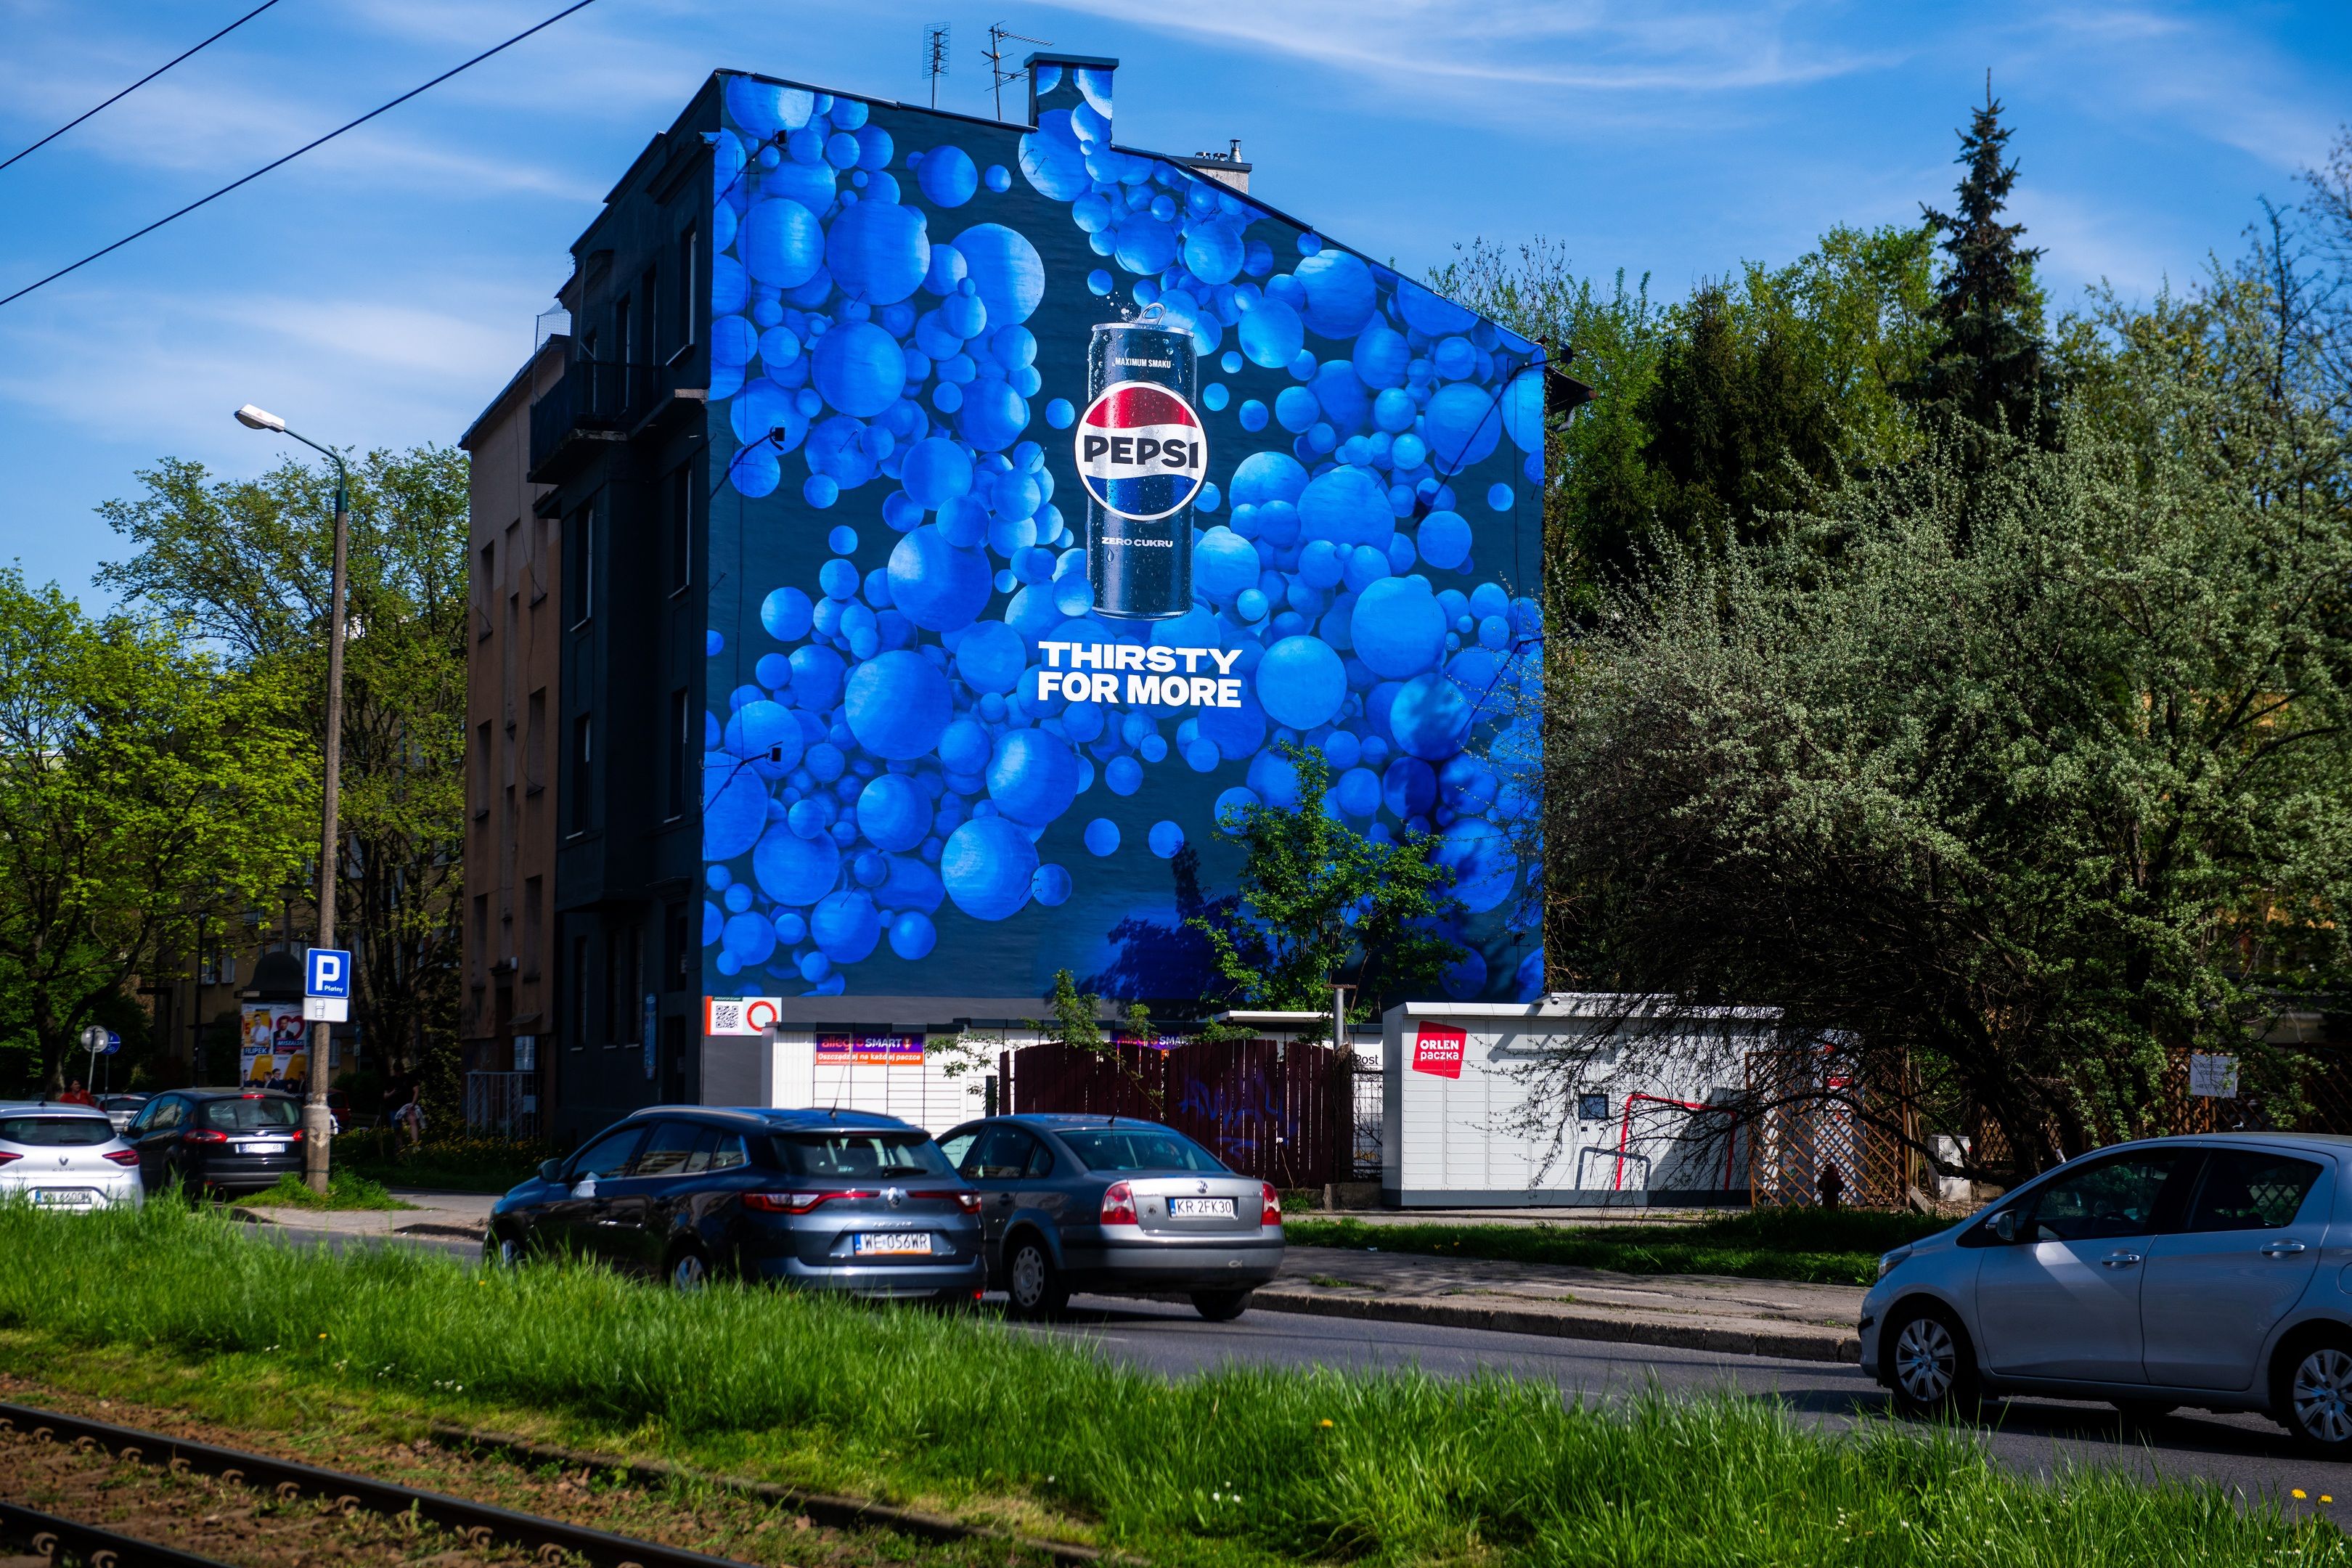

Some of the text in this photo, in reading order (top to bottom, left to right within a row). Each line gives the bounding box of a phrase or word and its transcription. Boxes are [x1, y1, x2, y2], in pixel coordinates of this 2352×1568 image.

[1115, 357, 1172, 369] MAXIMUM SMAKU
[1084, 435, 1199, 469] PEPSI
[1101, 536, 1174, 548] ZERO CUKRU
[1038, 640, 1244, 675] THIRSTY
[1038, 671, 1242, 709] FOR MORE
[315, 955, 341, 991] P
[821, 1035, 902, 1051] allegro SMART
[1420, 1040, 1459, 1050] ORLEN
[1420, 1051, 1459, 1062] paczka
[1177, 1199, 1232, 1214] KR 2FK30
[864, 1234, 928, 1249] WE 056WR
